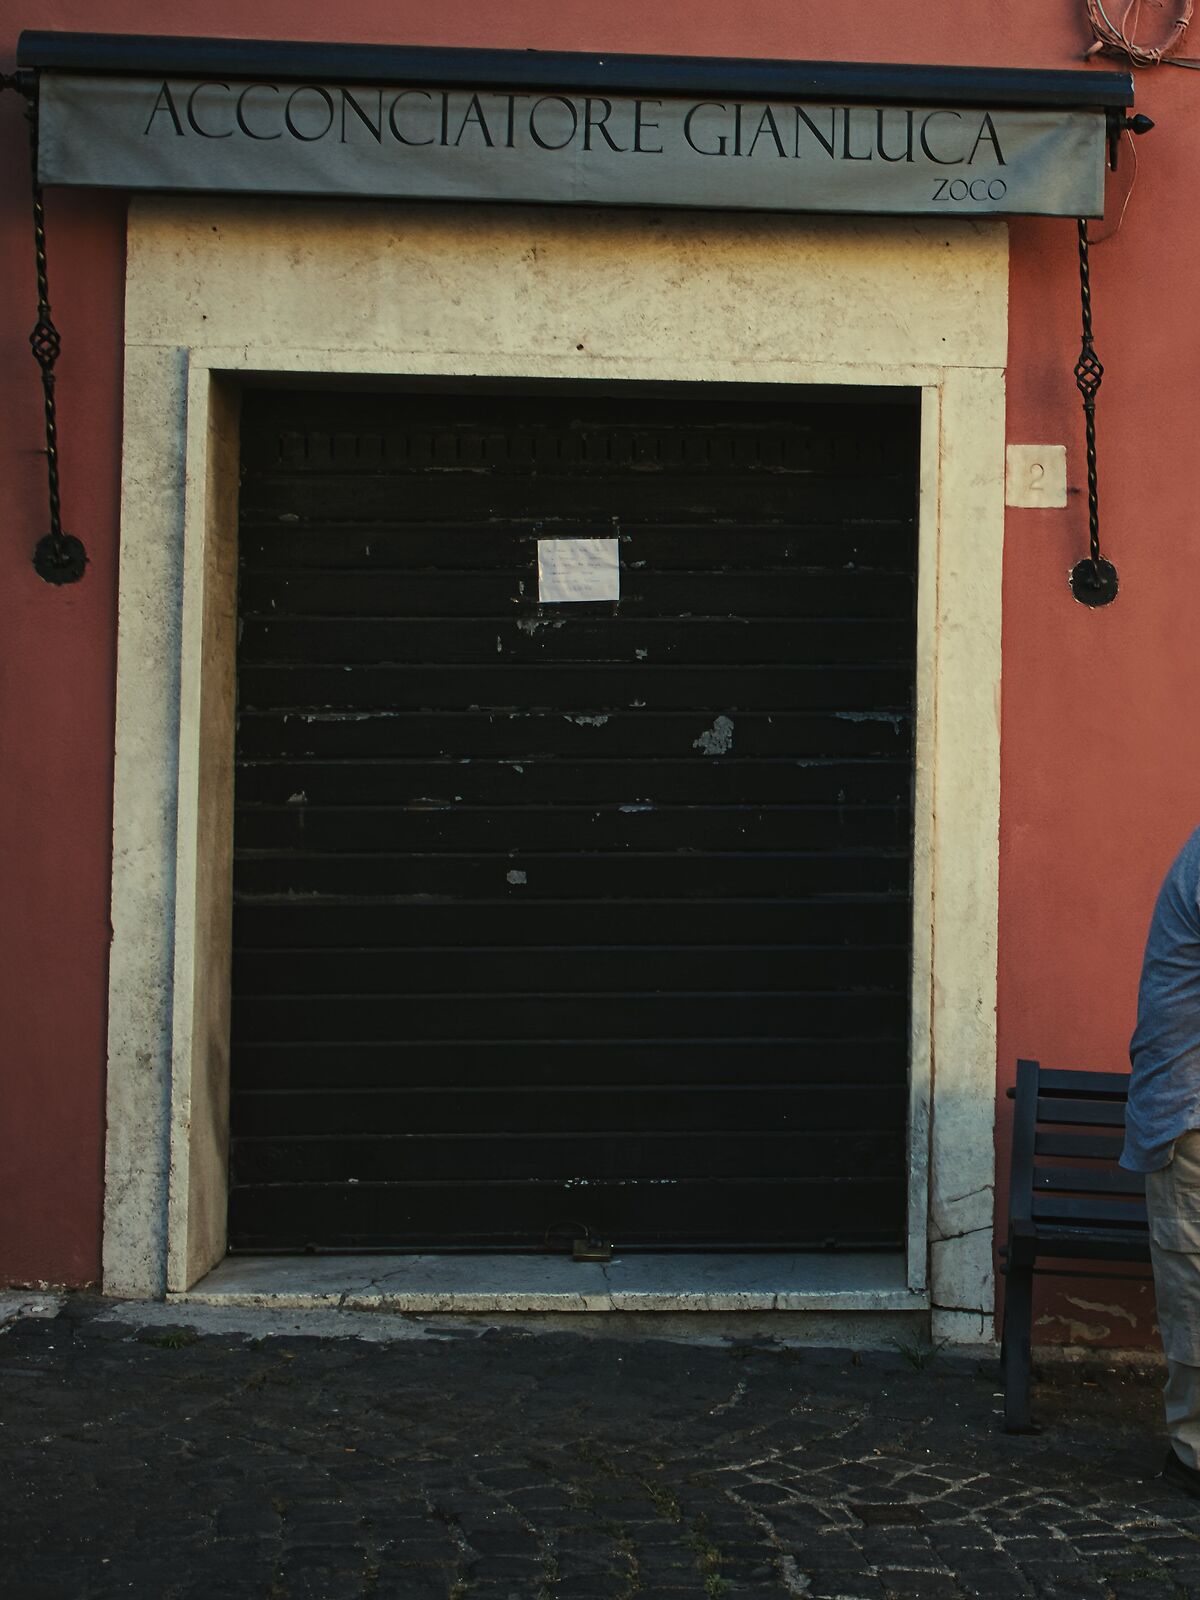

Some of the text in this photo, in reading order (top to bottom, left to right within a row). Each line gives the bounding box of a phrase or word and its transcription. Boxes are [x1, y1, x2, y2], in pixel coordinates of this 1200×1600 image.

[143, 80, 1007, 166] ACCONCIATORE GIANLUCA
[932, 177, 1007, 202] ZOCO
[1029, 463, 1045, 490] 2
